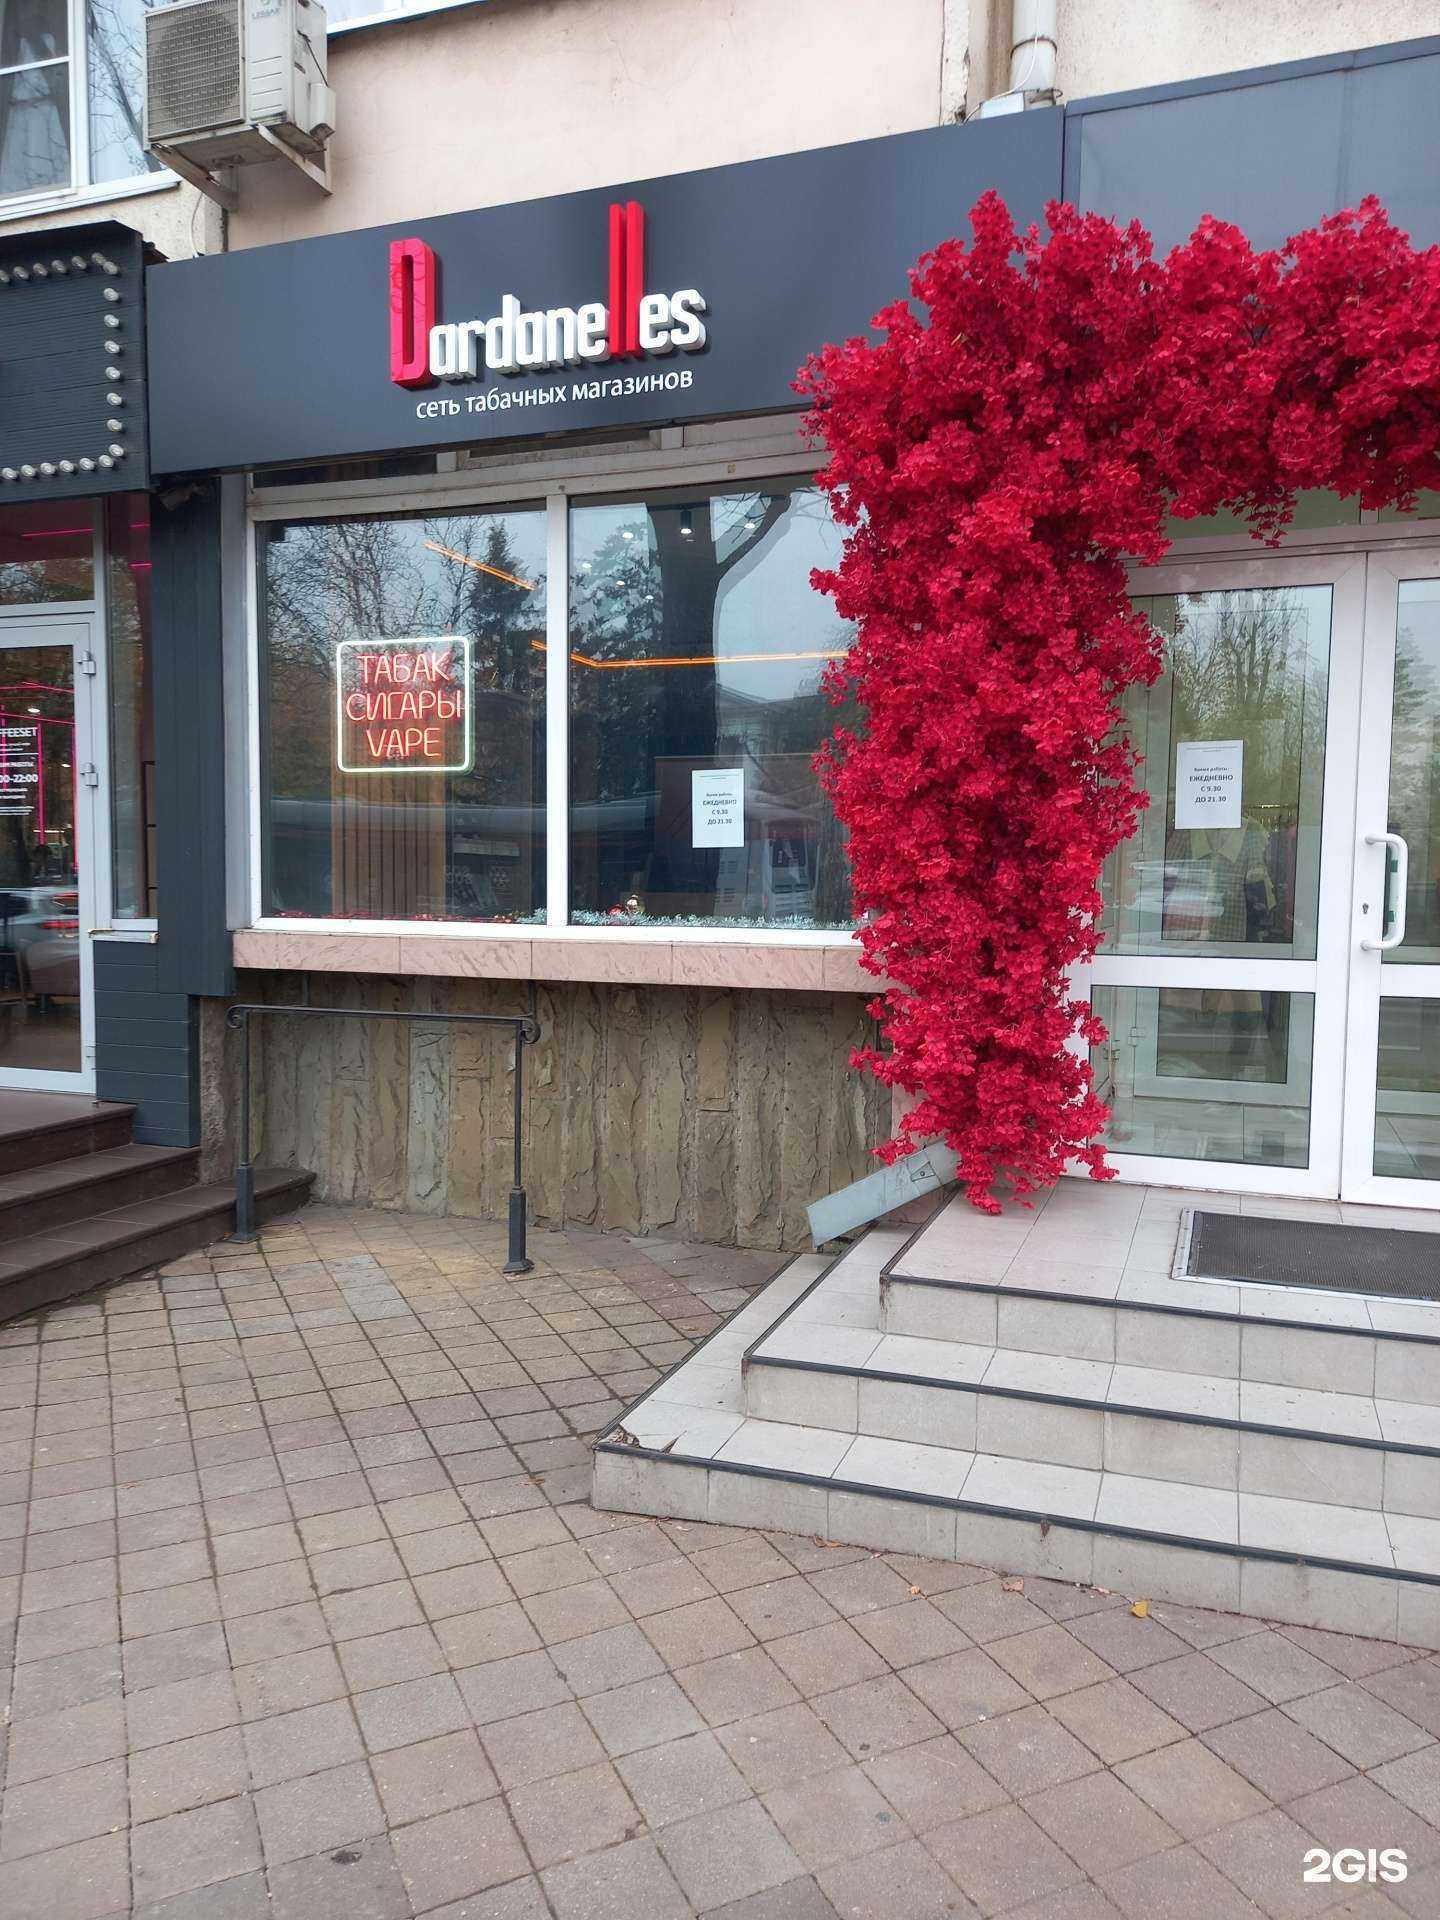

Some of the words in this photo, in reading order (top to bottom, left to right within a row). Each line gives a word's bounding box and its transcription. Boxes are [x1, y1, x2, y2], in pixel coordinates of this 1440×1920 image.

[389, 199, 707, 388] Dardanelles
[415, 399, 461, 419] сеть
[465, 386, 567, 414] табачных
[572, 370, 694, 401] магазинов
[356, 651, 451, 684] ТАБАК
[346, 689, 462, 721] СИГАРЫ
[366, 727, 441, 757] VAPE
[1189, 774, 1234, 783] ЕЖЕДНЕВНО
[1195, 796, 1206, 804] ДО
